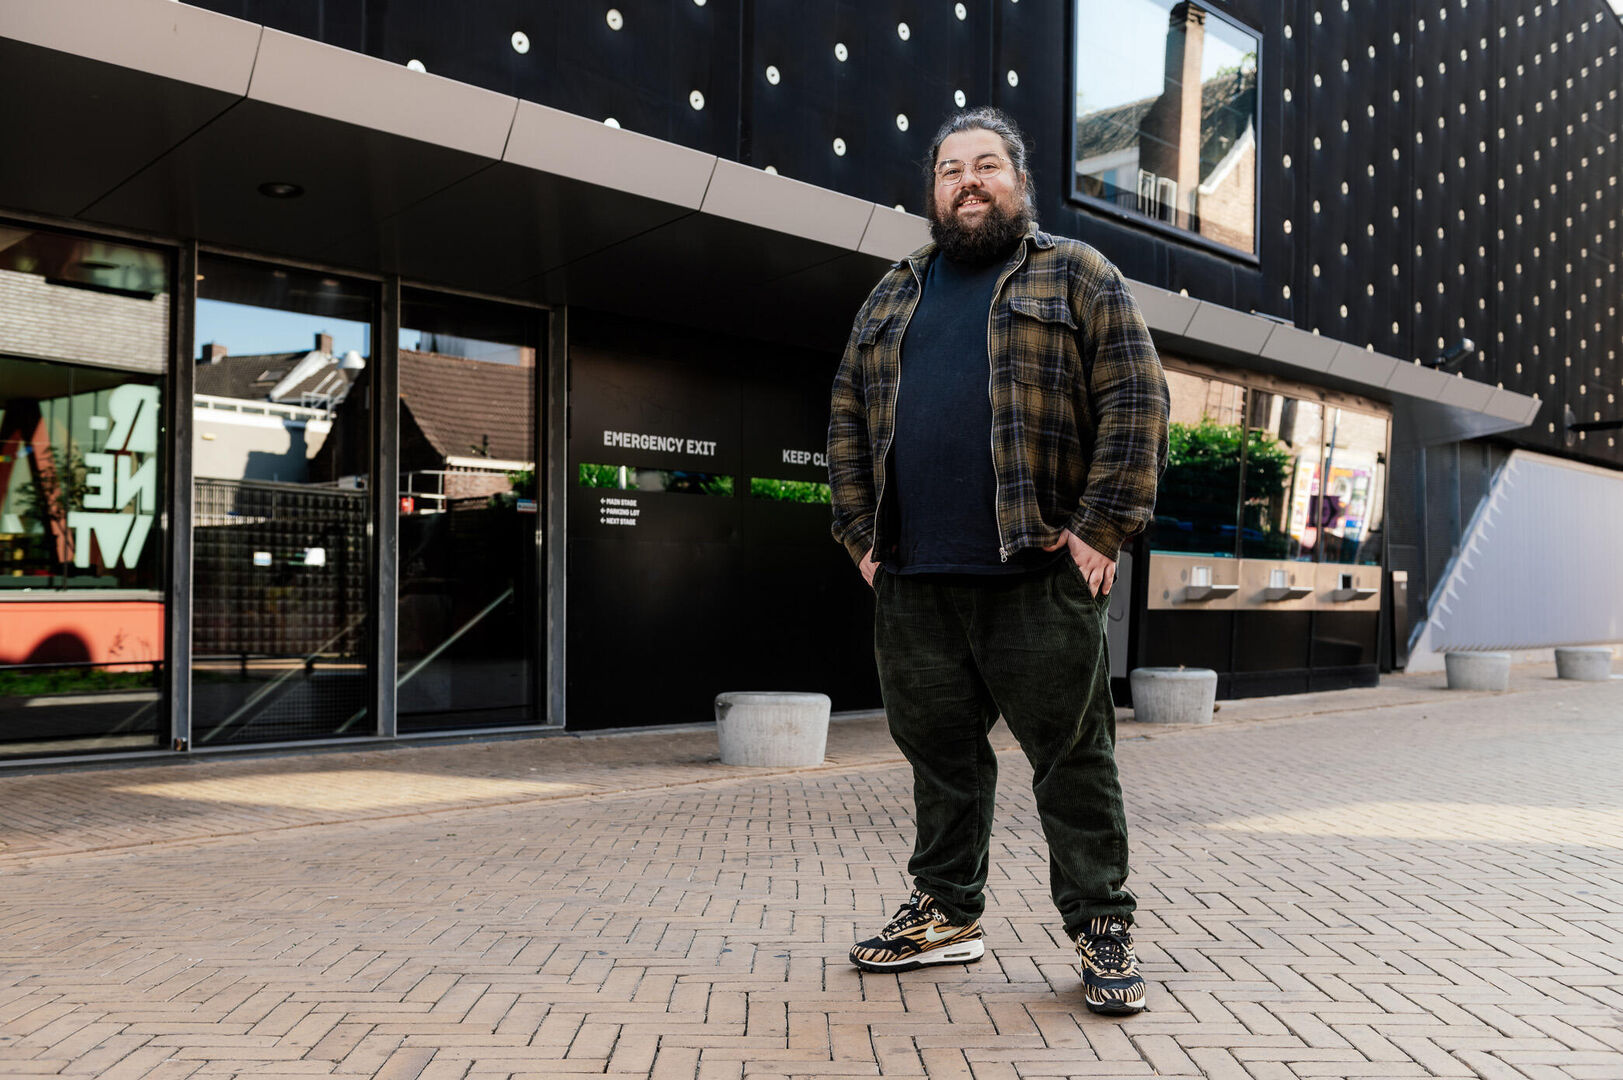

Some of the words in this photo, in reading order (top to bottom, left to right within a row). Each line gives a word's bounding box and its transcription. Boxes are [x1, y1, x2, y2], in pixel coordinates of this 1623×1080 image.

[603, 430, 684, 453] EMERGENCY
[686, 440, 716, 456] EXIT
[783, 449, 811, 464] KEEP
[606, 498, 620, 506] MAIN
[621, 498, 637, 507] STAGE
[606, 508, 629, 516] PARKING
[606, 517, 620, 525] NEXT
[620, 518, 636, 526] STAGE
